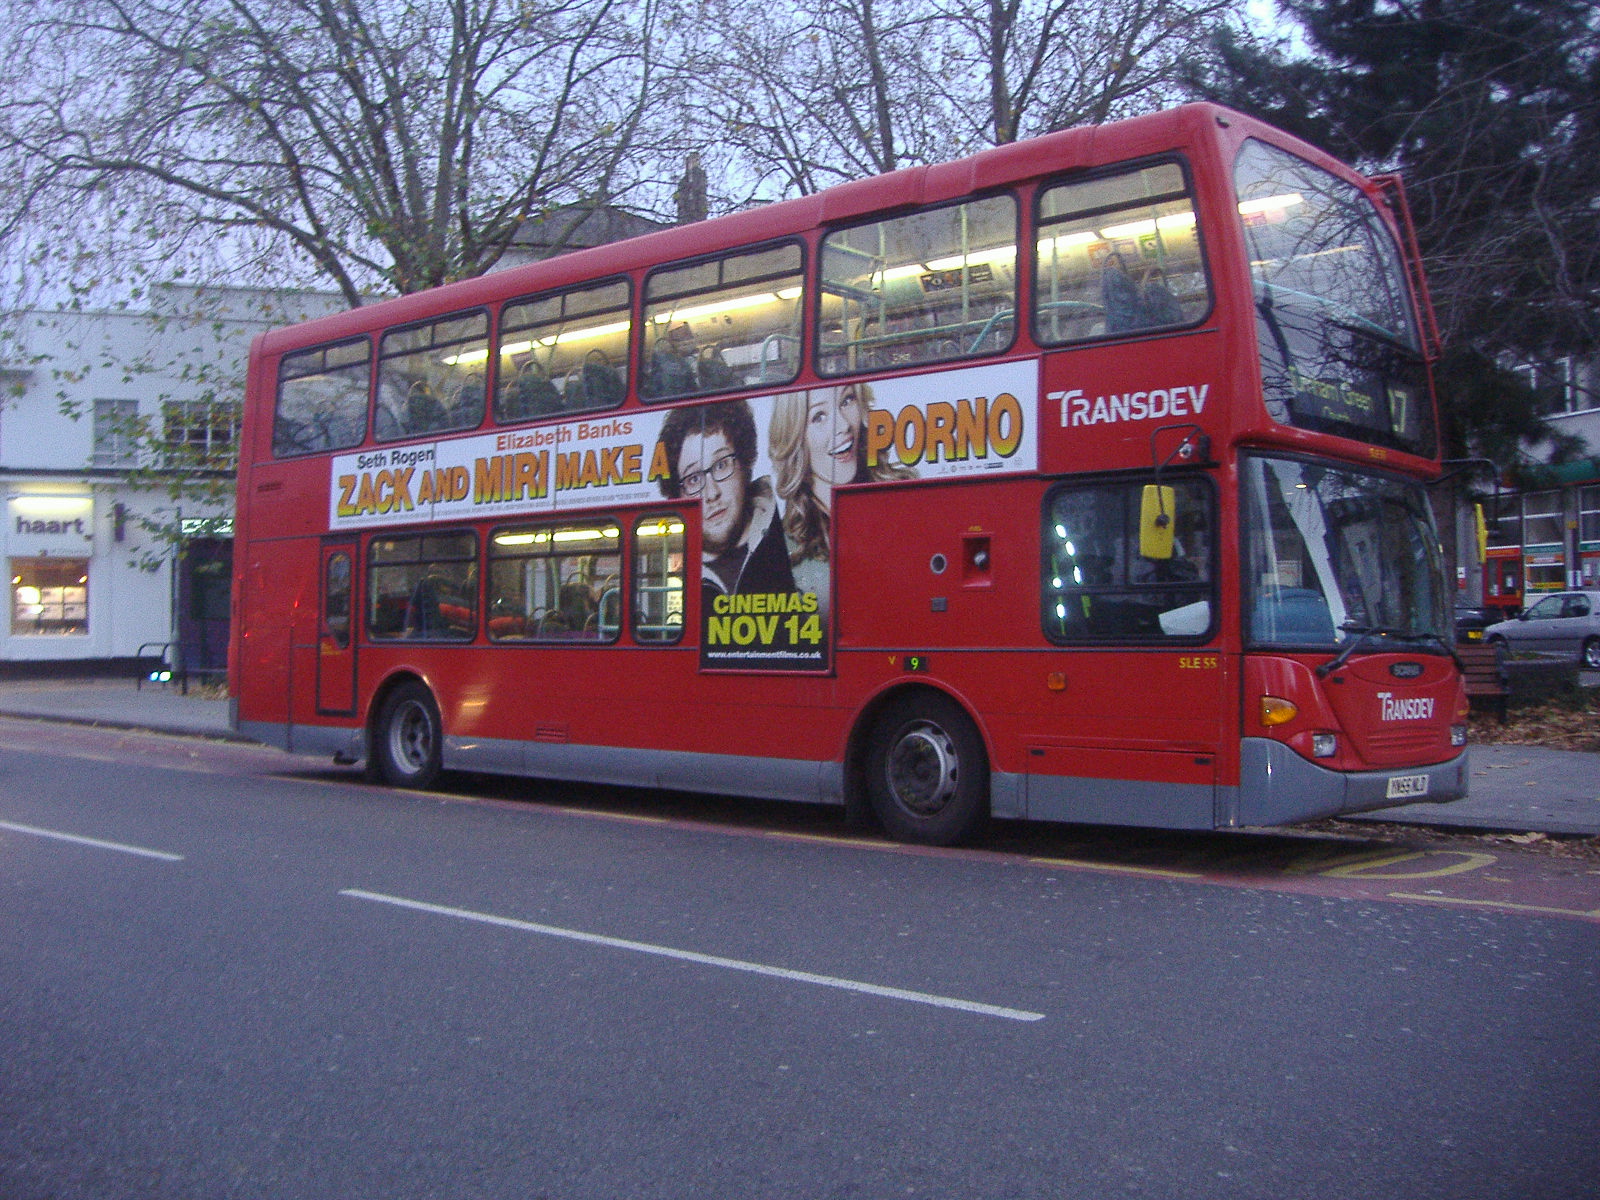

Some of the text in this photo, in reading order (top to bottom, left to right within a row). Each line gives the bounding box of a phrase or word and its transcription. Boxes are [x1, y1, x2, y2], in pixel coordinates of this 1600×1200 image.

[1047, 384, 1210, 428] TRANSDEV
[497, 420, 633, 451] Elizabeth Banks
[337, 467, 416, 518] ZACK
[417, 466, 470, 505] AND
[474, 450, 550, 505] MIRI
[555, 444, 643, 491] MAKE
[648, 441, 671, 482] A
[866, 393, 1024, 467] PORNO
[357, 449, 435, 470] Seth Rogen
[16, 515, 84, 534] haart
[713, 592, 818, 614] CINEMAS
[708, 614, 823, 645] NOV 14
[911, 657, 919, 671] 9
[1179, 657, 1201, 669] SLE
[1377, 692, 1434, 721] TRANSDEV
